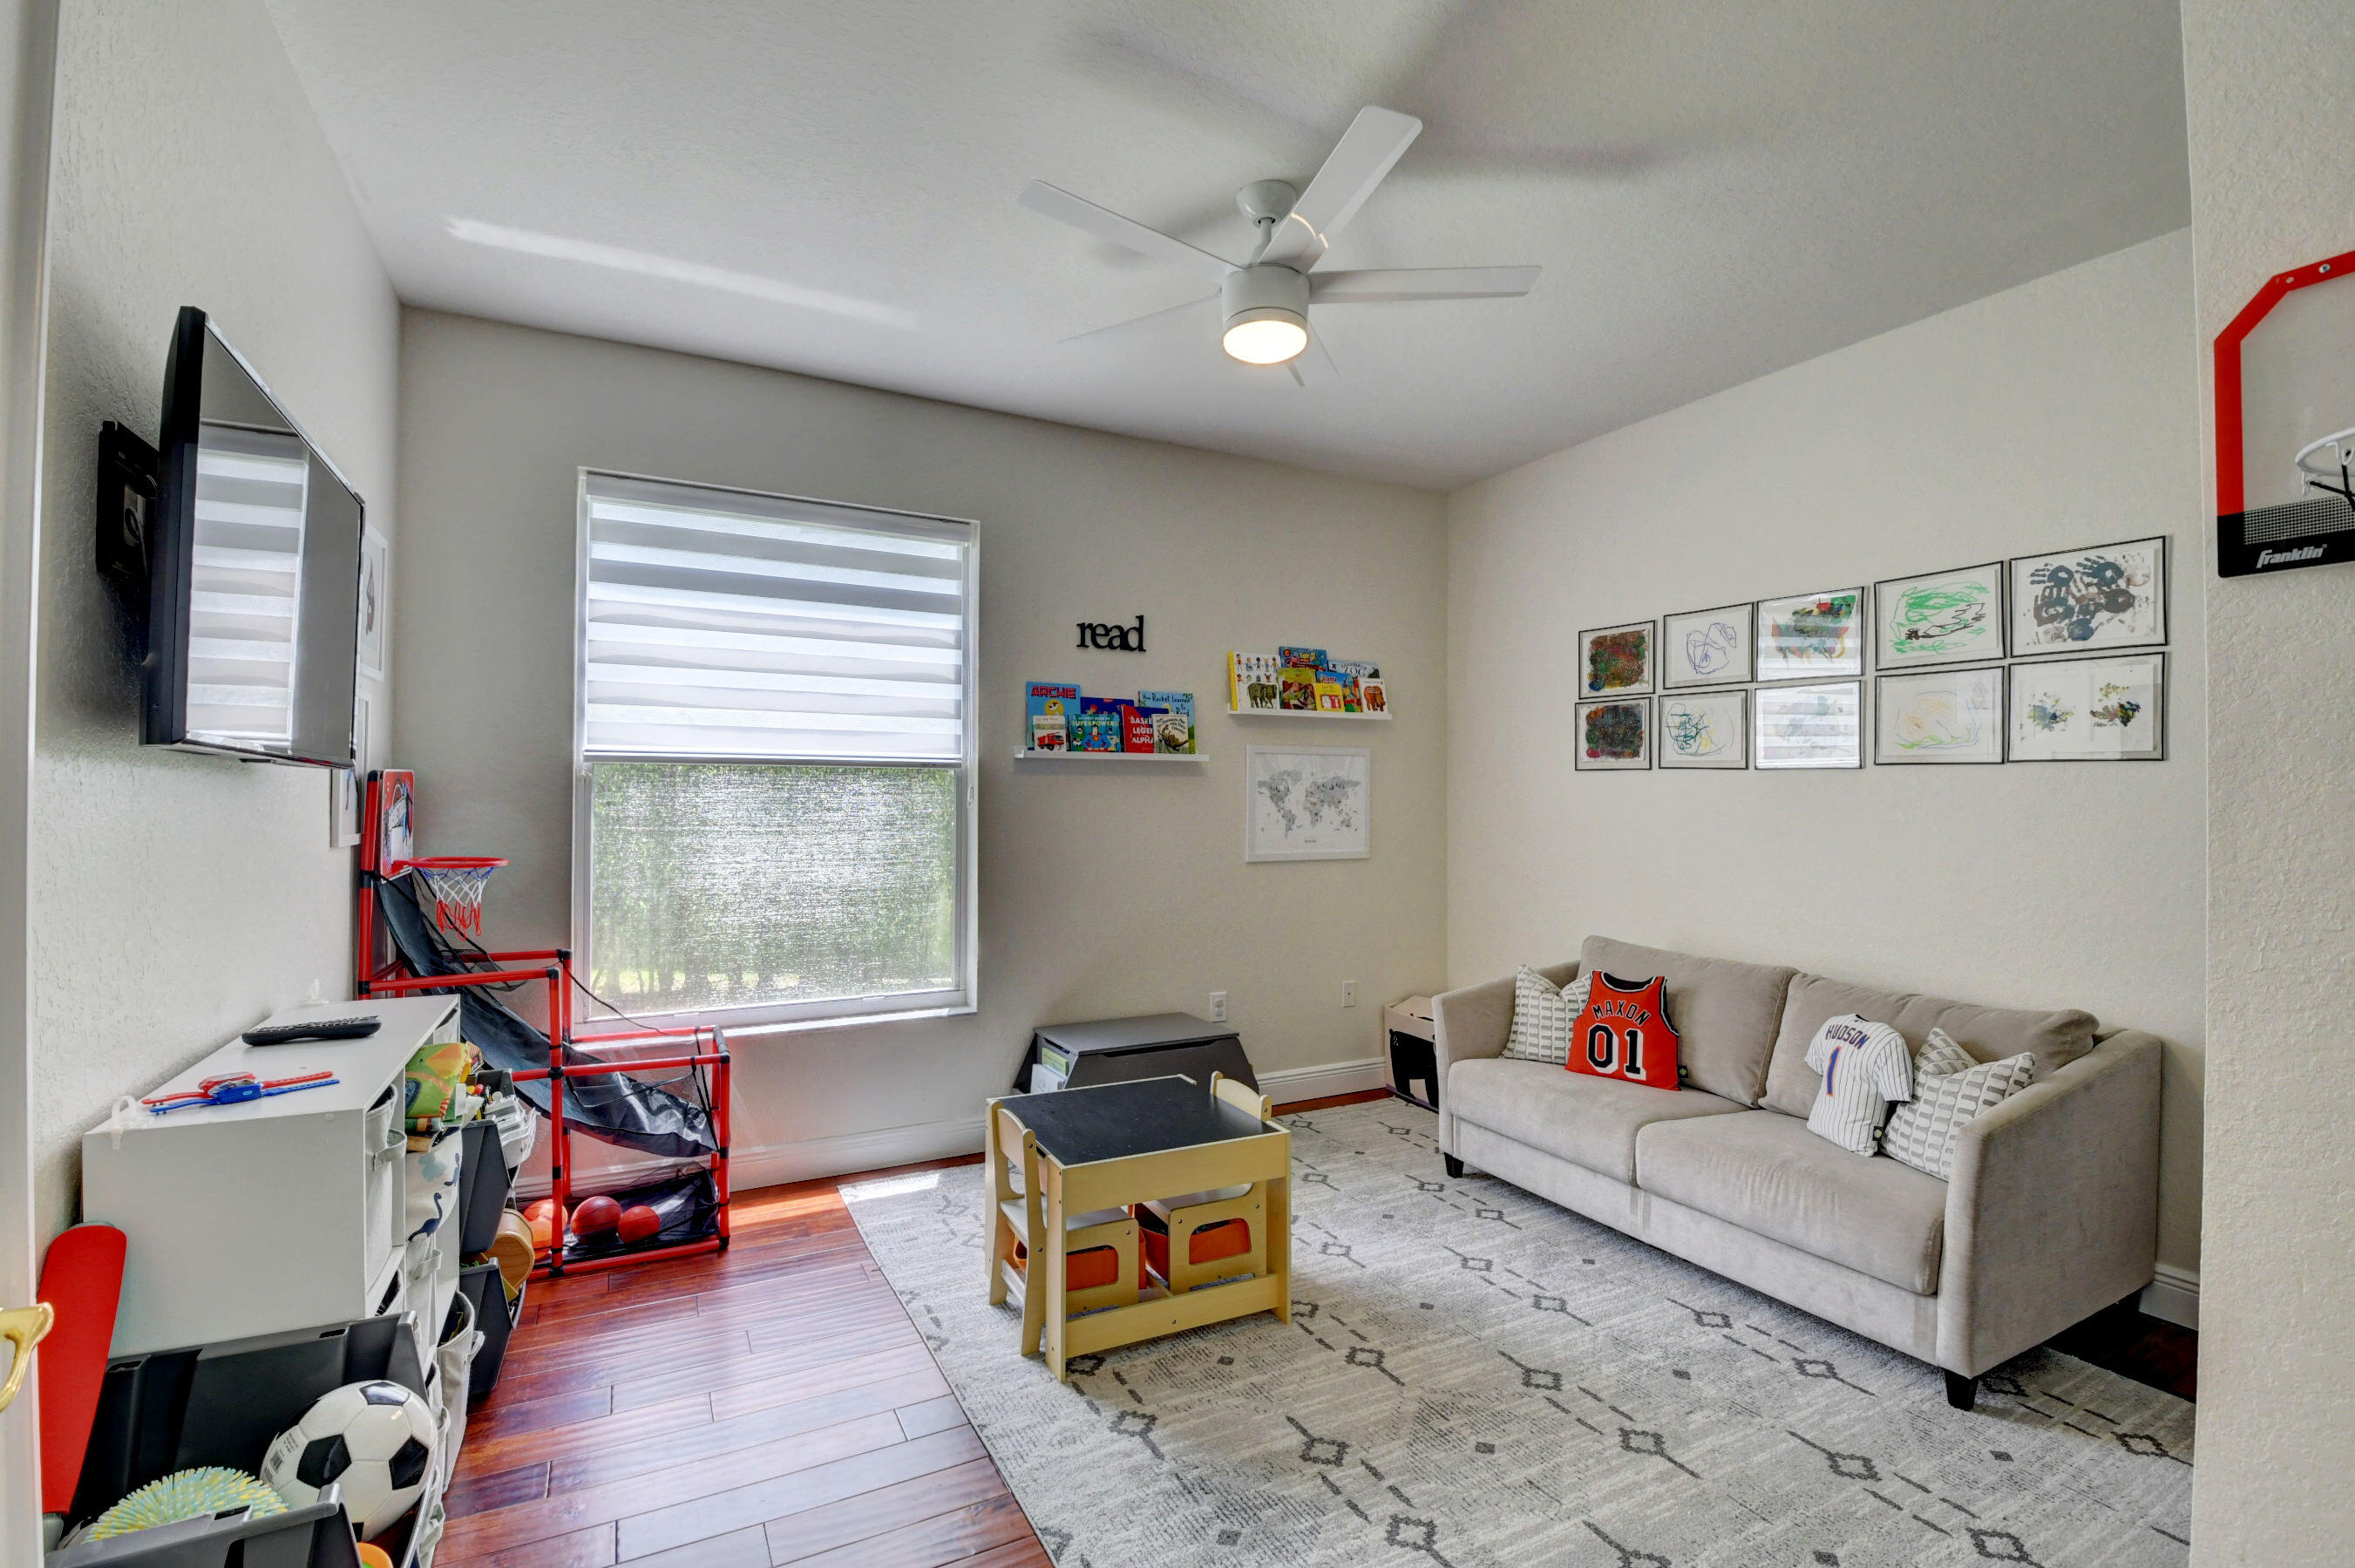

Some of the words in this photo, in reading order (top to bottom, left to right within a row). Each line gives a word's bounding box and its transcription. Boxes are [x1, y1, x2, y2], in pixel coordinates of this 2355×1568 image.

[1076, 614, 1146, 652] read
[1592, 1000, 1651, 1027] MAXON
[1587, 1023, 1646, 1081] 01
[1825, 1024, 1870, 1049] HUDSON
[1826, 1046, 1842, 1097] 1
